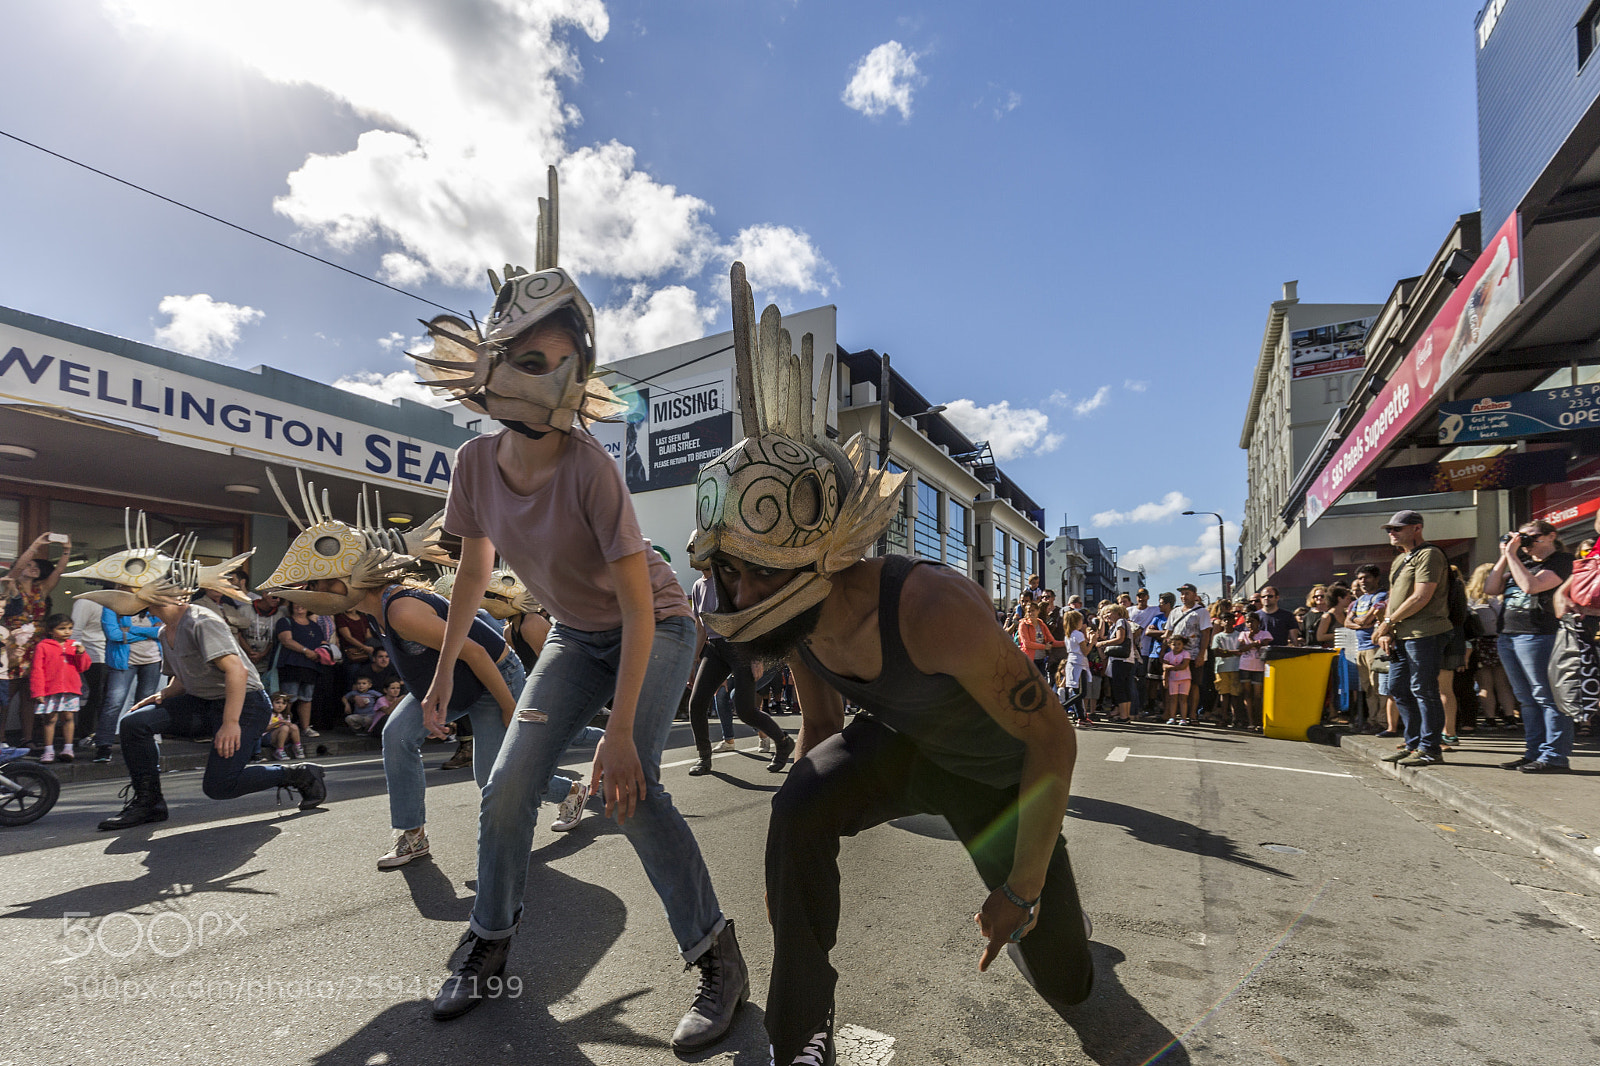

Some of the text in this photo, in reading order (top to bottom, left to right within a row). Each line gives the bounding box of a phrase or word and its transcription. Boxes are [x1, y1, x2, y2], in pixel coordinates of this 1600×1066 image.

[0, 346, 343, 457] WELLINGTON
[653, 388, 718, 424] MISSING
[1472, 402, 1510, 412] Anchor
[1568, 398, 1592, 409] 235
[1342, 436, 1364, 477] Patels
[1364, 383, 1410, 452] Superette
[655, 432, 690, 446] LAST SEEN ON
[659, 443, 677, 456] BLAIR
[653, 447, 723, 469] PLEASE RETURN TO BREWERY
[1450, 463, 1486, 478] Lotto
[1551, 506, 1579, 524] Services
